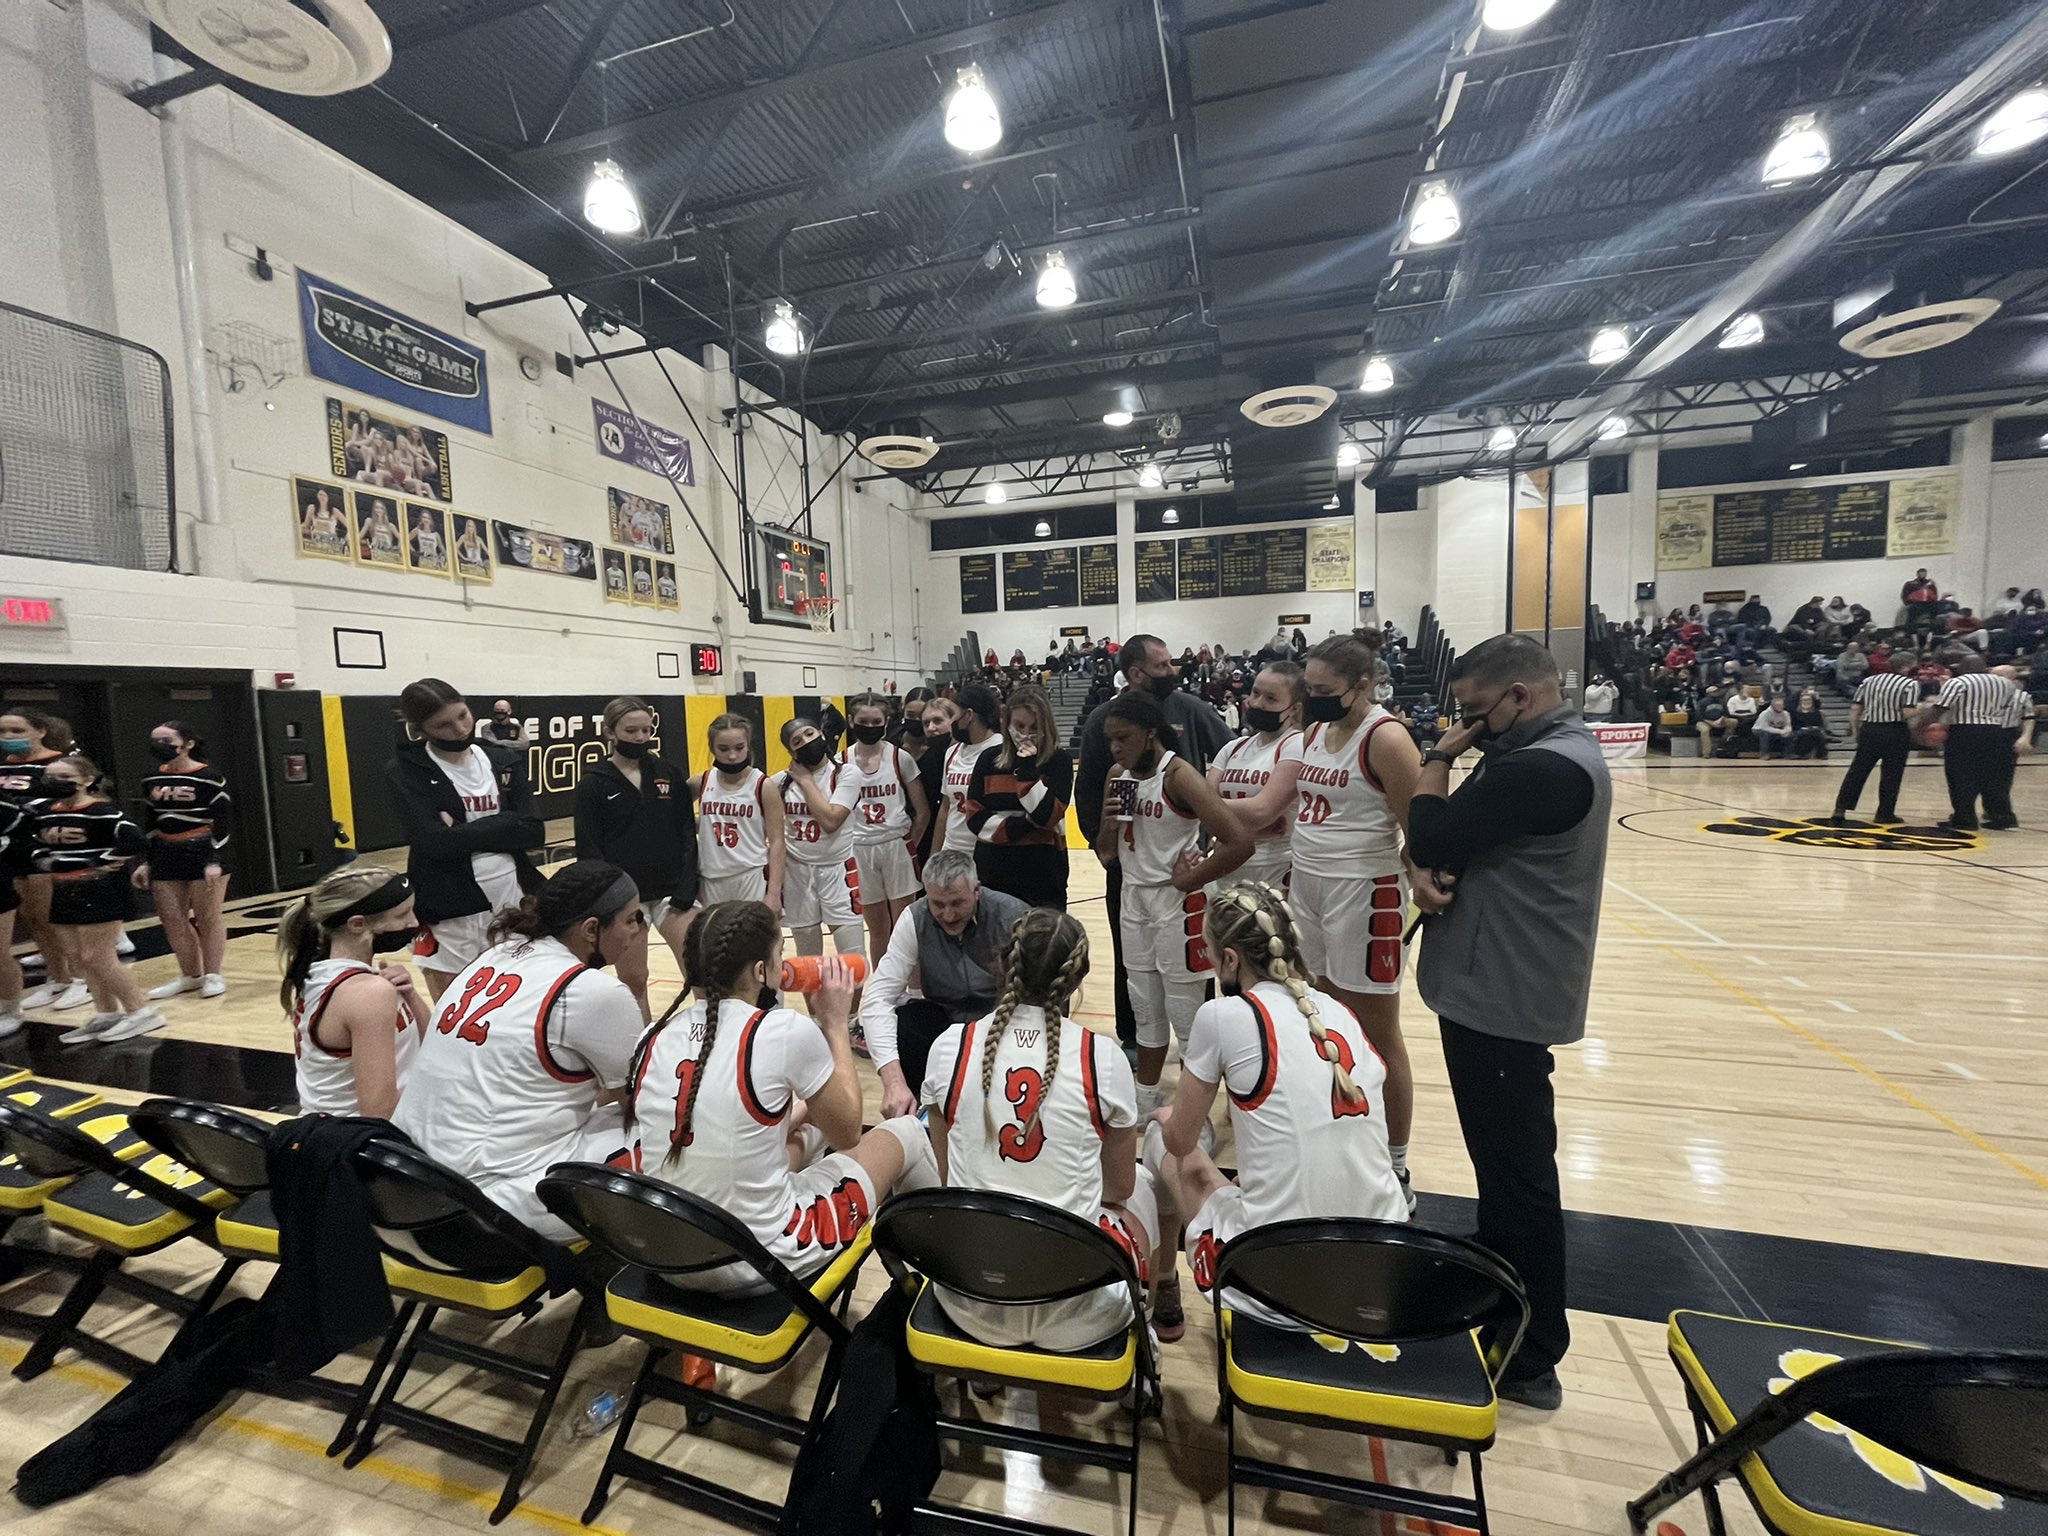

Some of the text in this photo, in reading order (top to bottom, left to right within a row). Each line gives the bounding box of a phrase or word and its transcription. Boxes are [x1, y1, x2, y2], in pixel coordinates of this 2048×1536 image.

[322, 308, 385, 347] STAY
[411, 346, 475, 383] GAME
[329, 418, 346, 476] SENIORS
[1311, 555, 1351, 564] CHAMPIONS
[699, 650, 717, 671] 30
[549, 715, 584, 739] OF
[1600, 729, 1645, 741] SPORTS
[702, 802, 754, 818] WATERLOO
[862, 803, 887, 825] 12
[1298, 790, 1334, 825] 20
[712, 822, 740, 848] 15
[793, 820, 821, 843] 10
[435, 966, 523, 1047] 32
[1014, 1029, 1040, 1048] W
[1309, 1028, 1370, 1120] 2
[669, 1058, 697, 1147] 1
[998, 1066, 1048, 1164] 3
